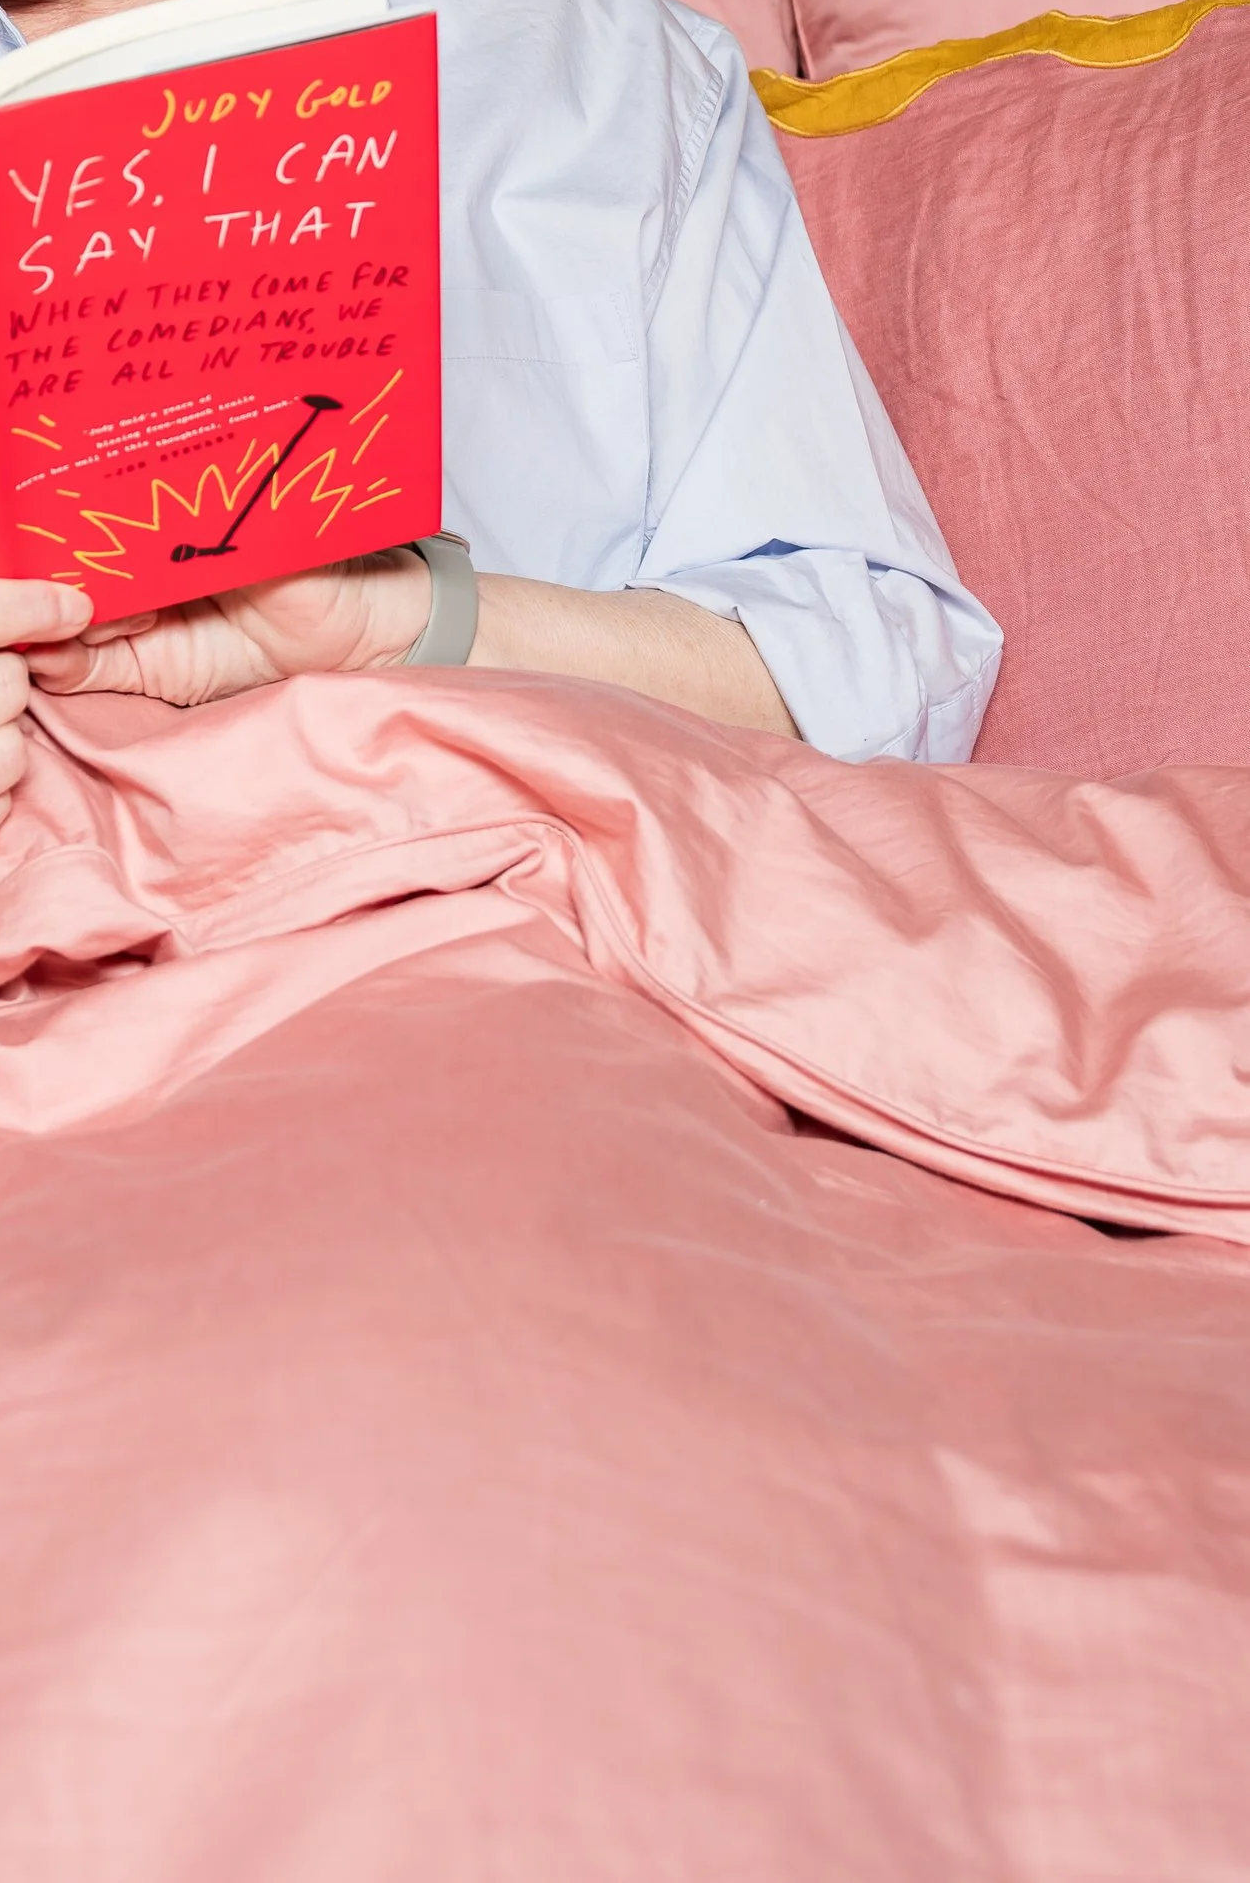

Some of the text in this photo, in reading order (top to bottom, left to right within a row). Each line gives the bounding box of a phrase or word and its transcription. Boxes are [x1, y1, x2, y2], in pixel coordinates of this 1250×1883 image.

[141, 79, 392, 139] JUDY GOLD
[8, 129, 398, 228] YES, I CAN
[18, 200, 377, 295] SAY THAT
[4, 298, 383, 373] THE COMEDIANS, WE
[9, 261, 410, 340] WHEN THEY COME FOR
[7, 334, 397, 408] ARE ALL IN TROUBLE
